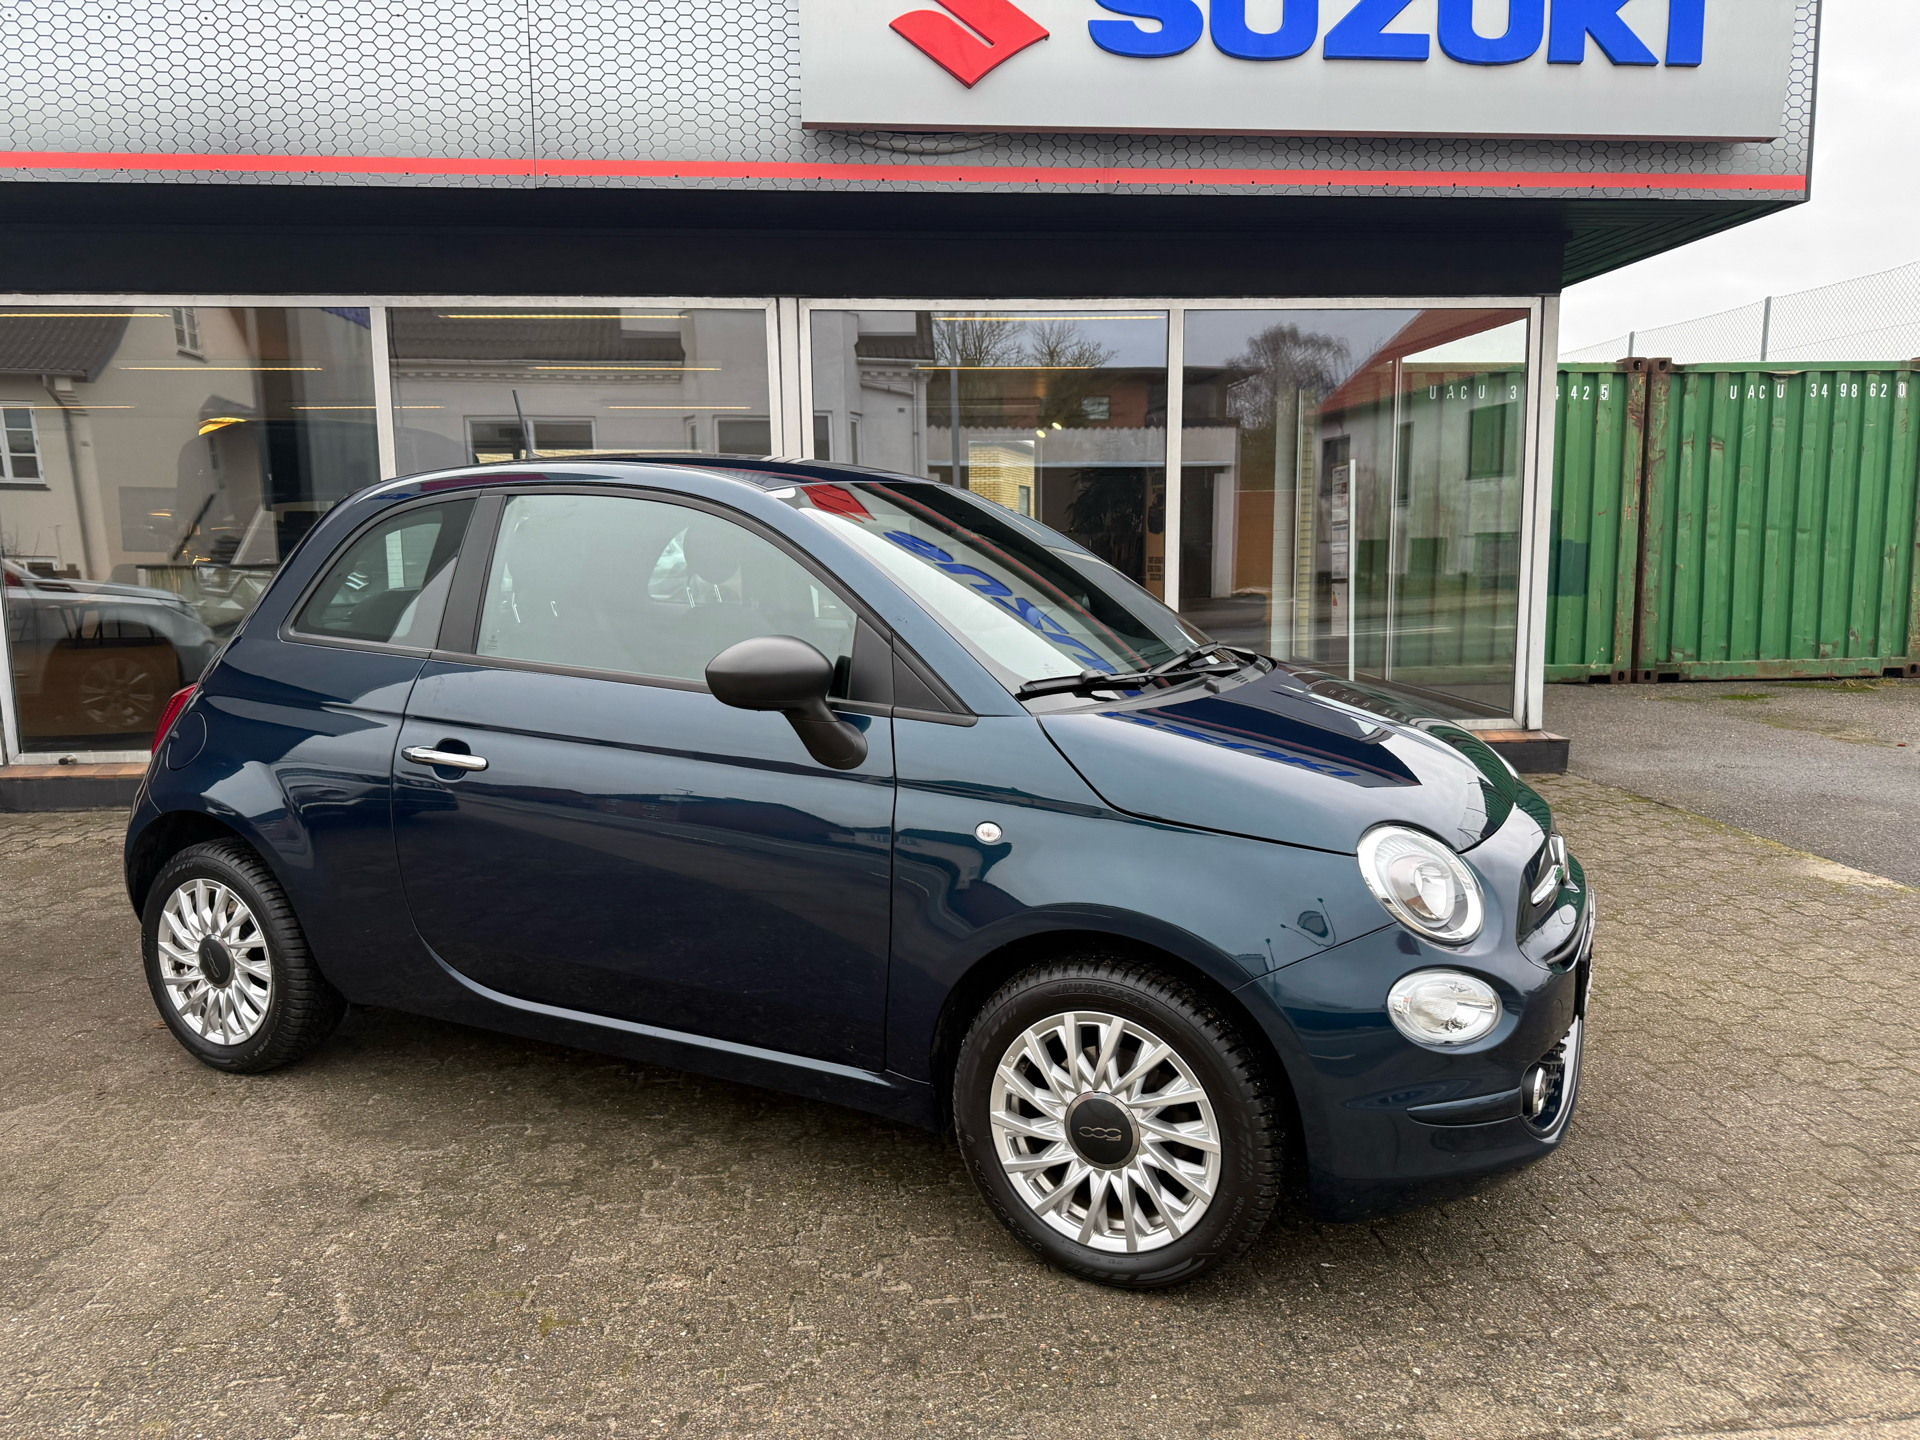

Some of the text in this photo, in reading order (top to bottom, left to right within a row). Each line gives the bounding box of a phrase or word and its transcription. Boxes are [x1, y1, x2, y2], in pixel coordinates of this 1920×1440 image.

[1088, 0, 1705, 67] SUZUKI
[1429, 384, 1485, 400] UACU
[1729, 384, 1785, 400] UACU
